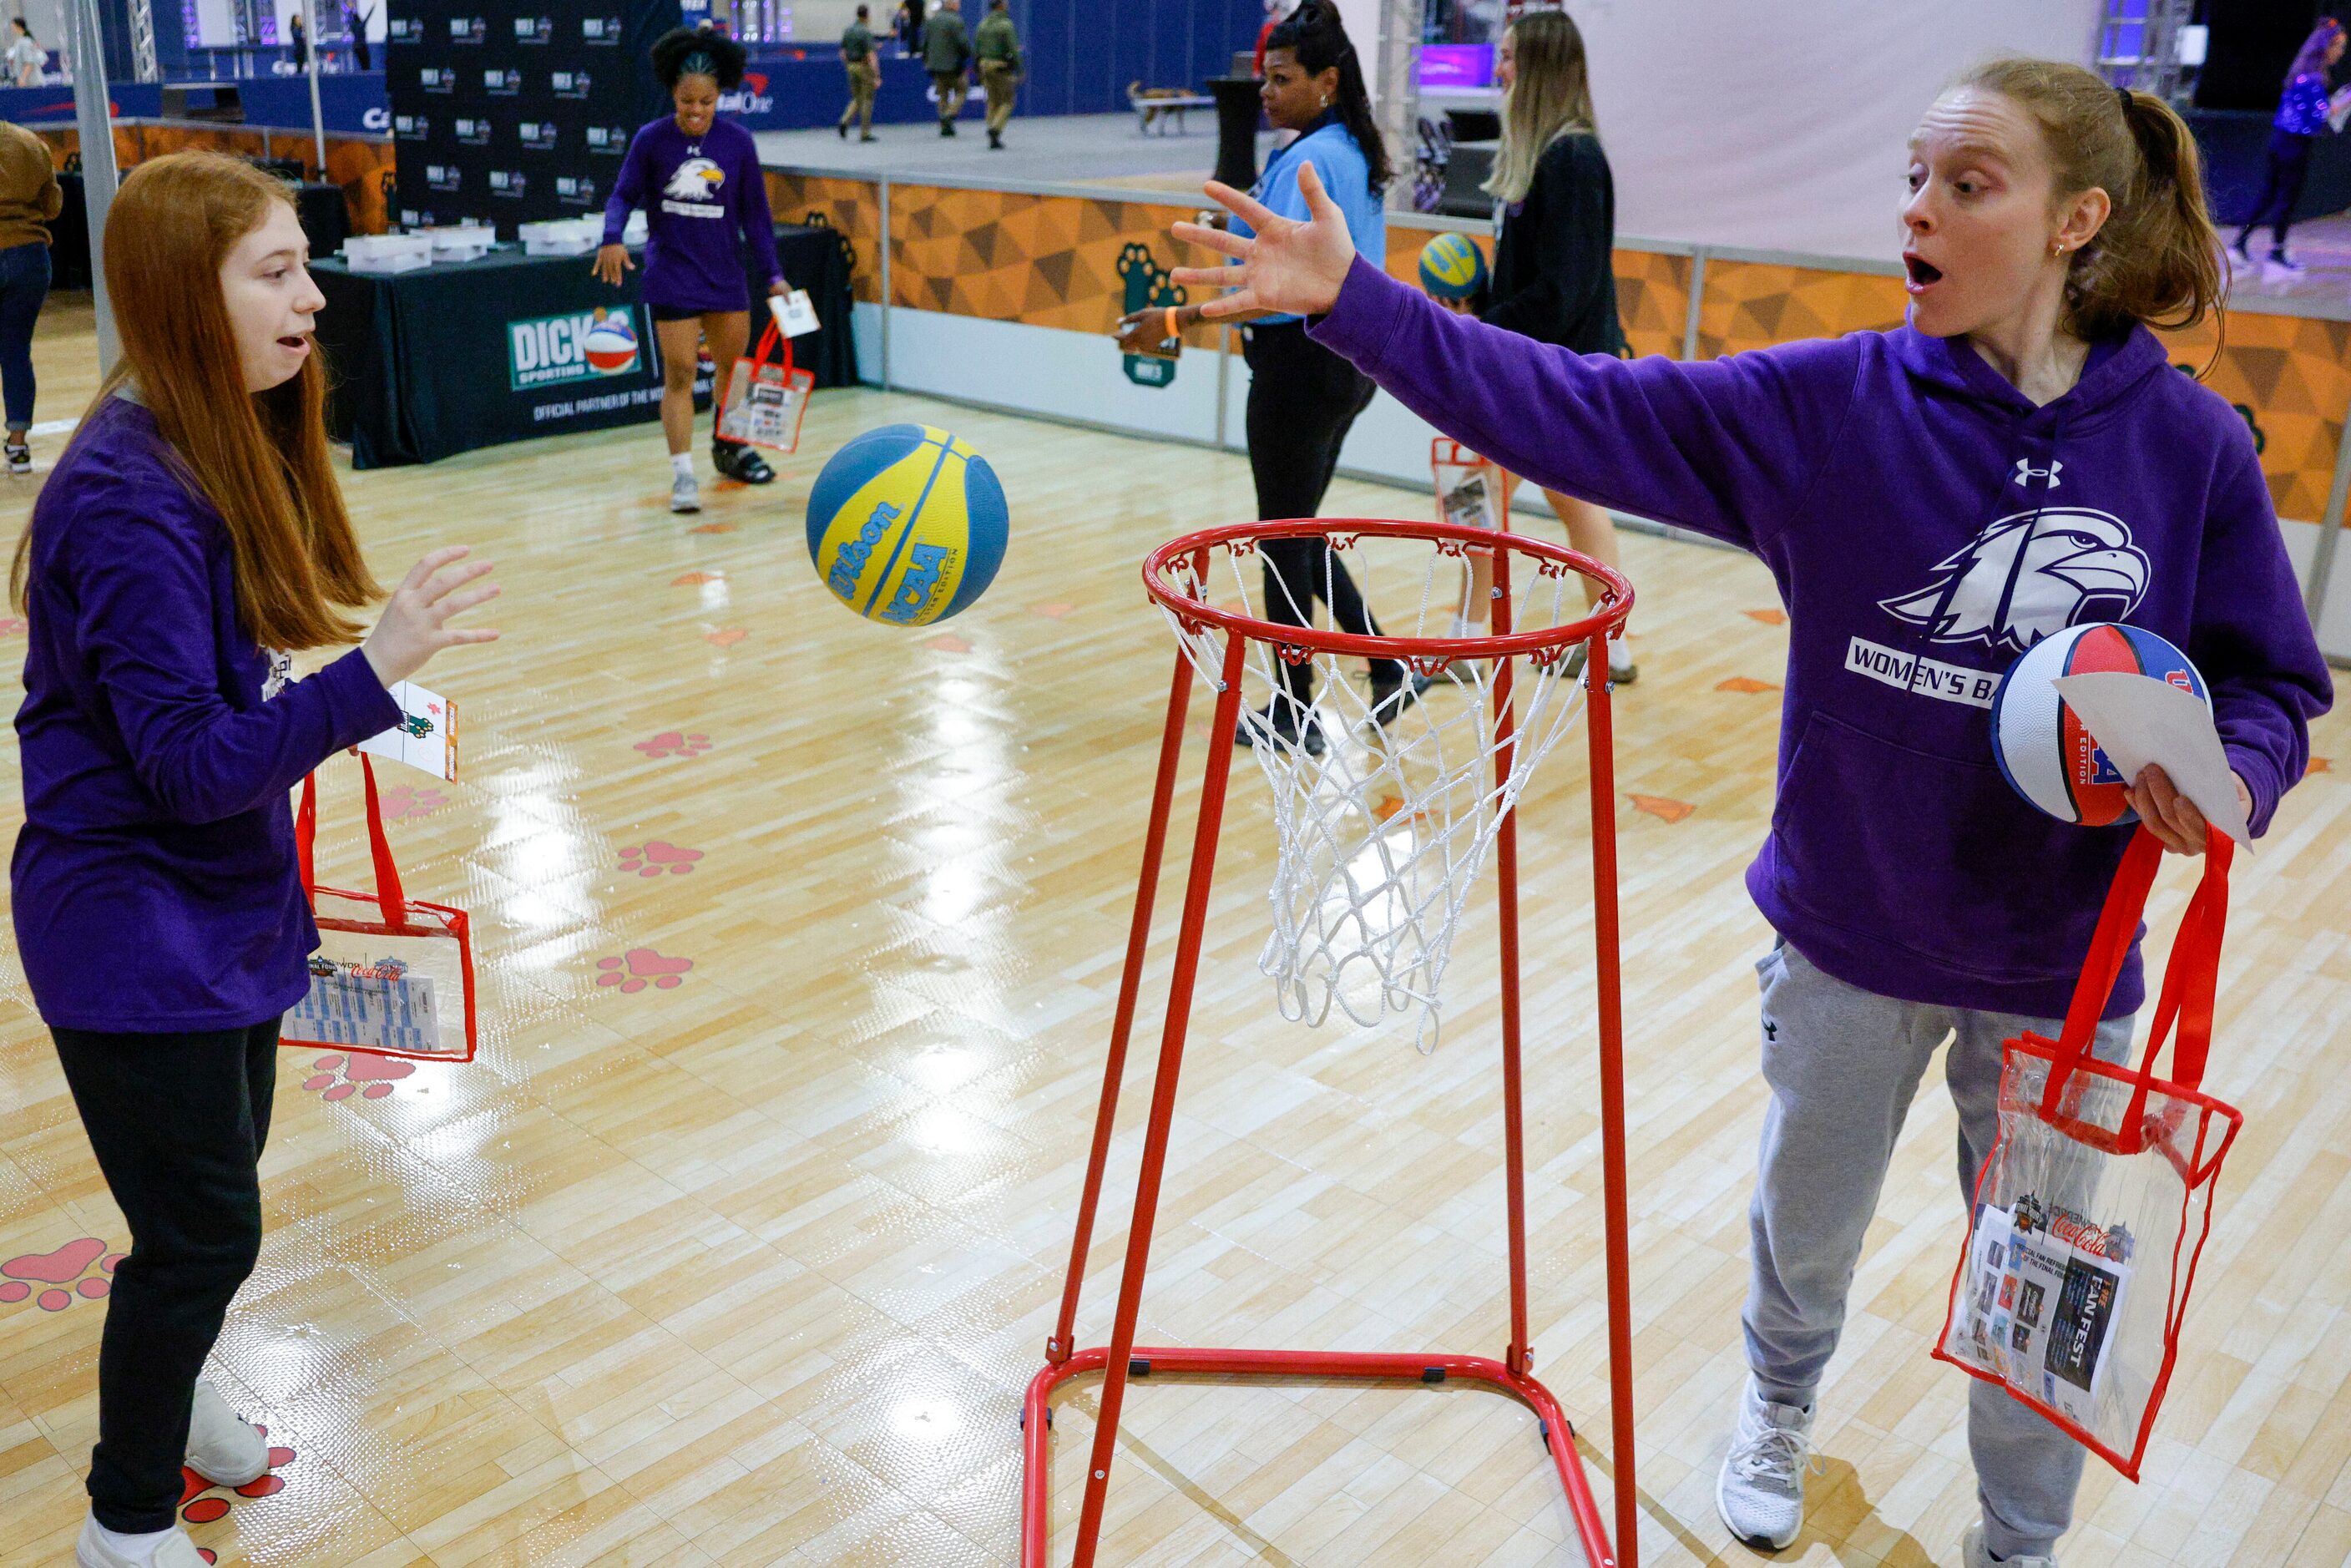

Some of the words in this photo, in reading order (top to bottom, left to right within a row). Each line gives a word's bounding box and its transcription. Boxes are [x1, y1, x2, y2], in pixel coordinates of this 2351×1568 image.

[518, 362, 585, 385] SPORTING
[533, 401, 575, 422] OFFICIAL
[575, 393, 619, 414] PARTNER
[619, 392, 629, 407] OF
[630, 388, 647, 405] THE
[828, 501, 901, 599] Wilson
[879, 542, 948, 625] NCAA
[1854, 644, 1967, 695] WOMEN'S
[2079, 737, 2087, 784] EDITION
[2030, 1258, 2039, 1267] THE
[2039, 1263, 2054, 1275] FINAL
[2036, 1252, 2046, 1262] FAN
[2084, 1275, 2102, 1317] FAN
[2070, 1317, 2091, 1368] FEST
